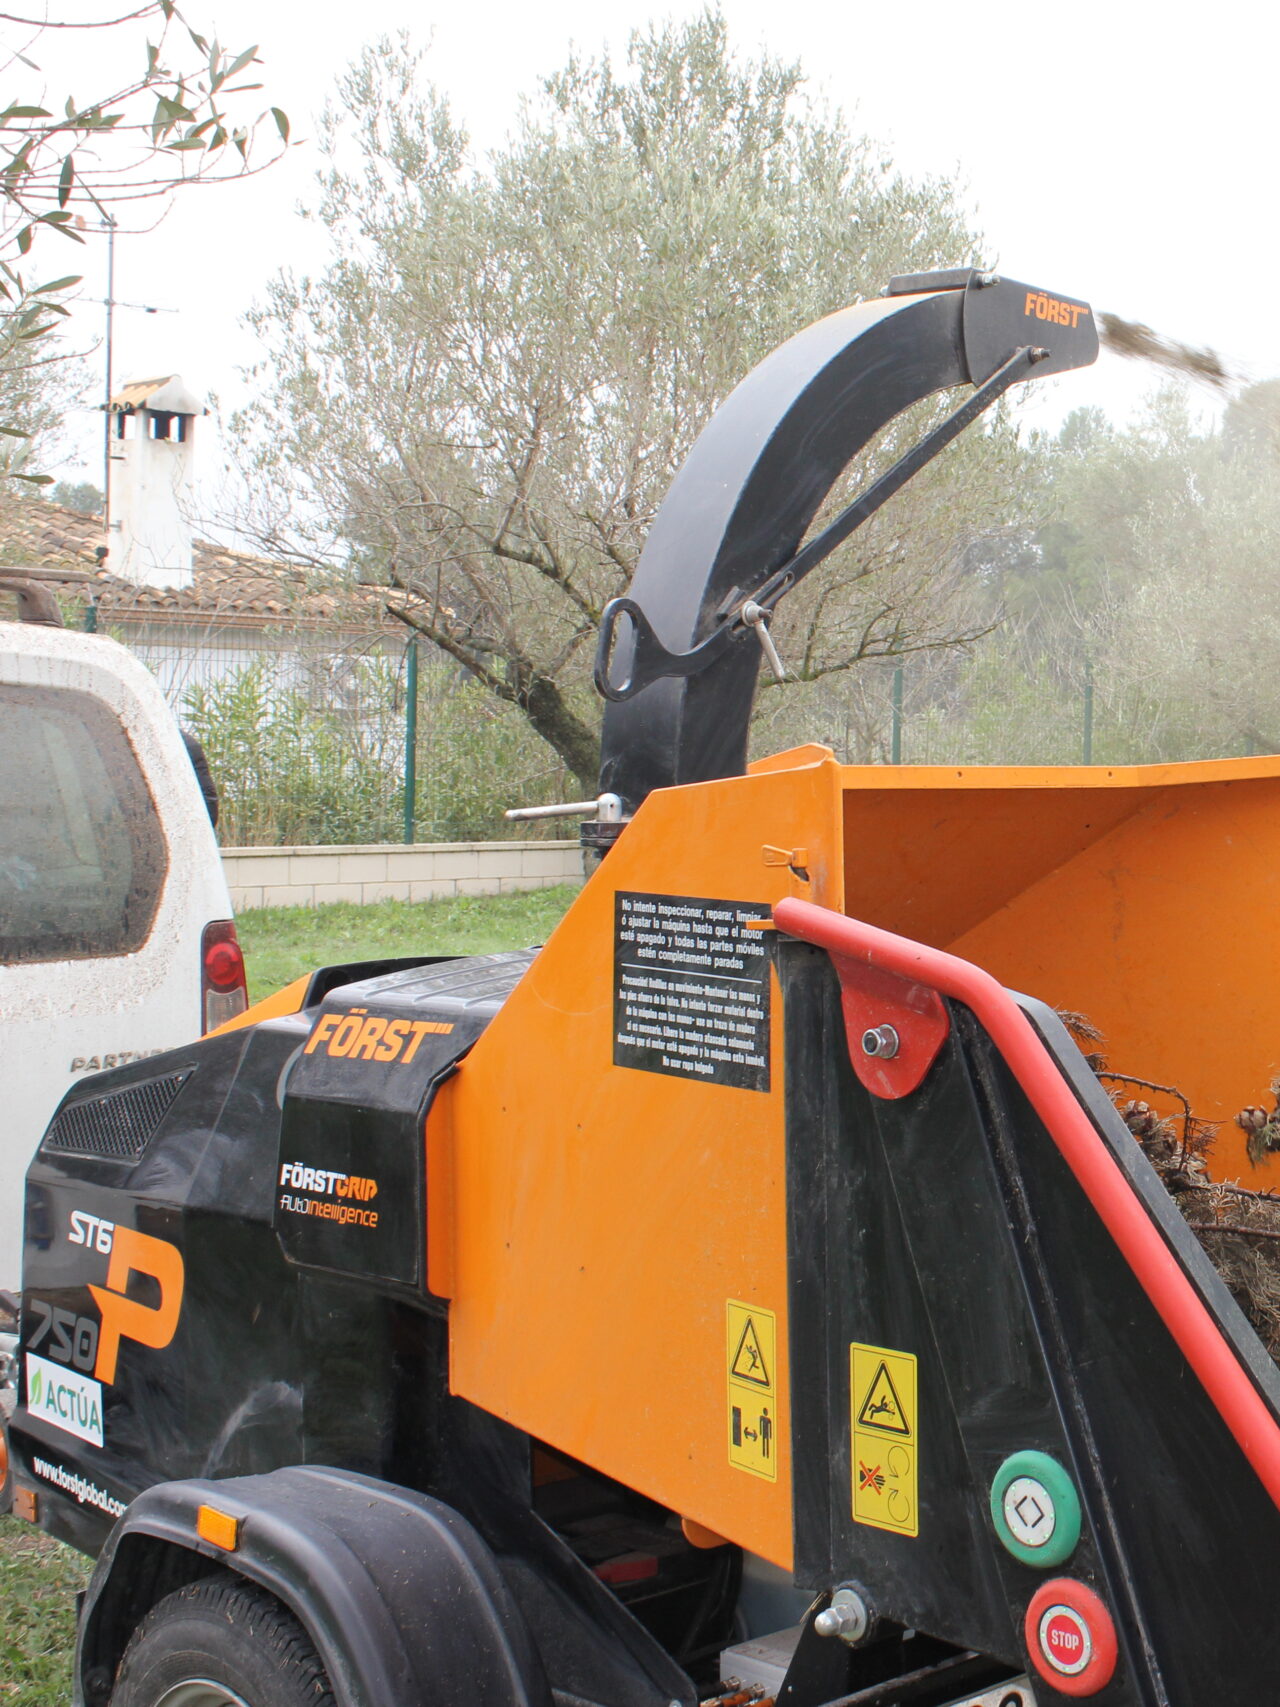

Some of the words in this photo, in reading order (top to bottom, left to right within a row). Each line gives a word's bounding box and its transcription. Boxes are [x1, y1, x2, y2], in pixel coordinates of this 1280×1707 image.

[1025, 291, 1088, 328] FÖRST
[622, 899, 632, 911] No
[633, 900, 656, 914] intente
[658, 902, 704, 921] inspeccionar,
[705, 910, 734, 923] reparar,
[620, 930, 635, 941] esté
[636, 932, 666, 946] apagado
[667, 936, 673, 948] y
[674, 935, 695, 948] todas
[696, 937, 708, 950] las
[709, 940, 734, 953] partes
[735, 942, 765, 956] móviles
[628, 915, 652, 929] ajustar
[653, 917, 660, 929] la
[661, 918, 691, 934] máquina
[692, 921, 713, 935] hasta
[714, 926, 729, 938] que
[731, 925, 739, 938] el
[740, 929, 764, 940] motor
[637, 947, 657, 959] estén
[658, 950, 712, 966] completamente
[714, 956, 744, 970] paradas
[304, 1008, 455, 1064] FÖRST
[68, 1210, 114, 1255] ST6
[26, 1298, 99, 1372] 750
[45, 1380, 101, 1435] ACTÚA
[1051, 1630, 1080, 1651] STOP
